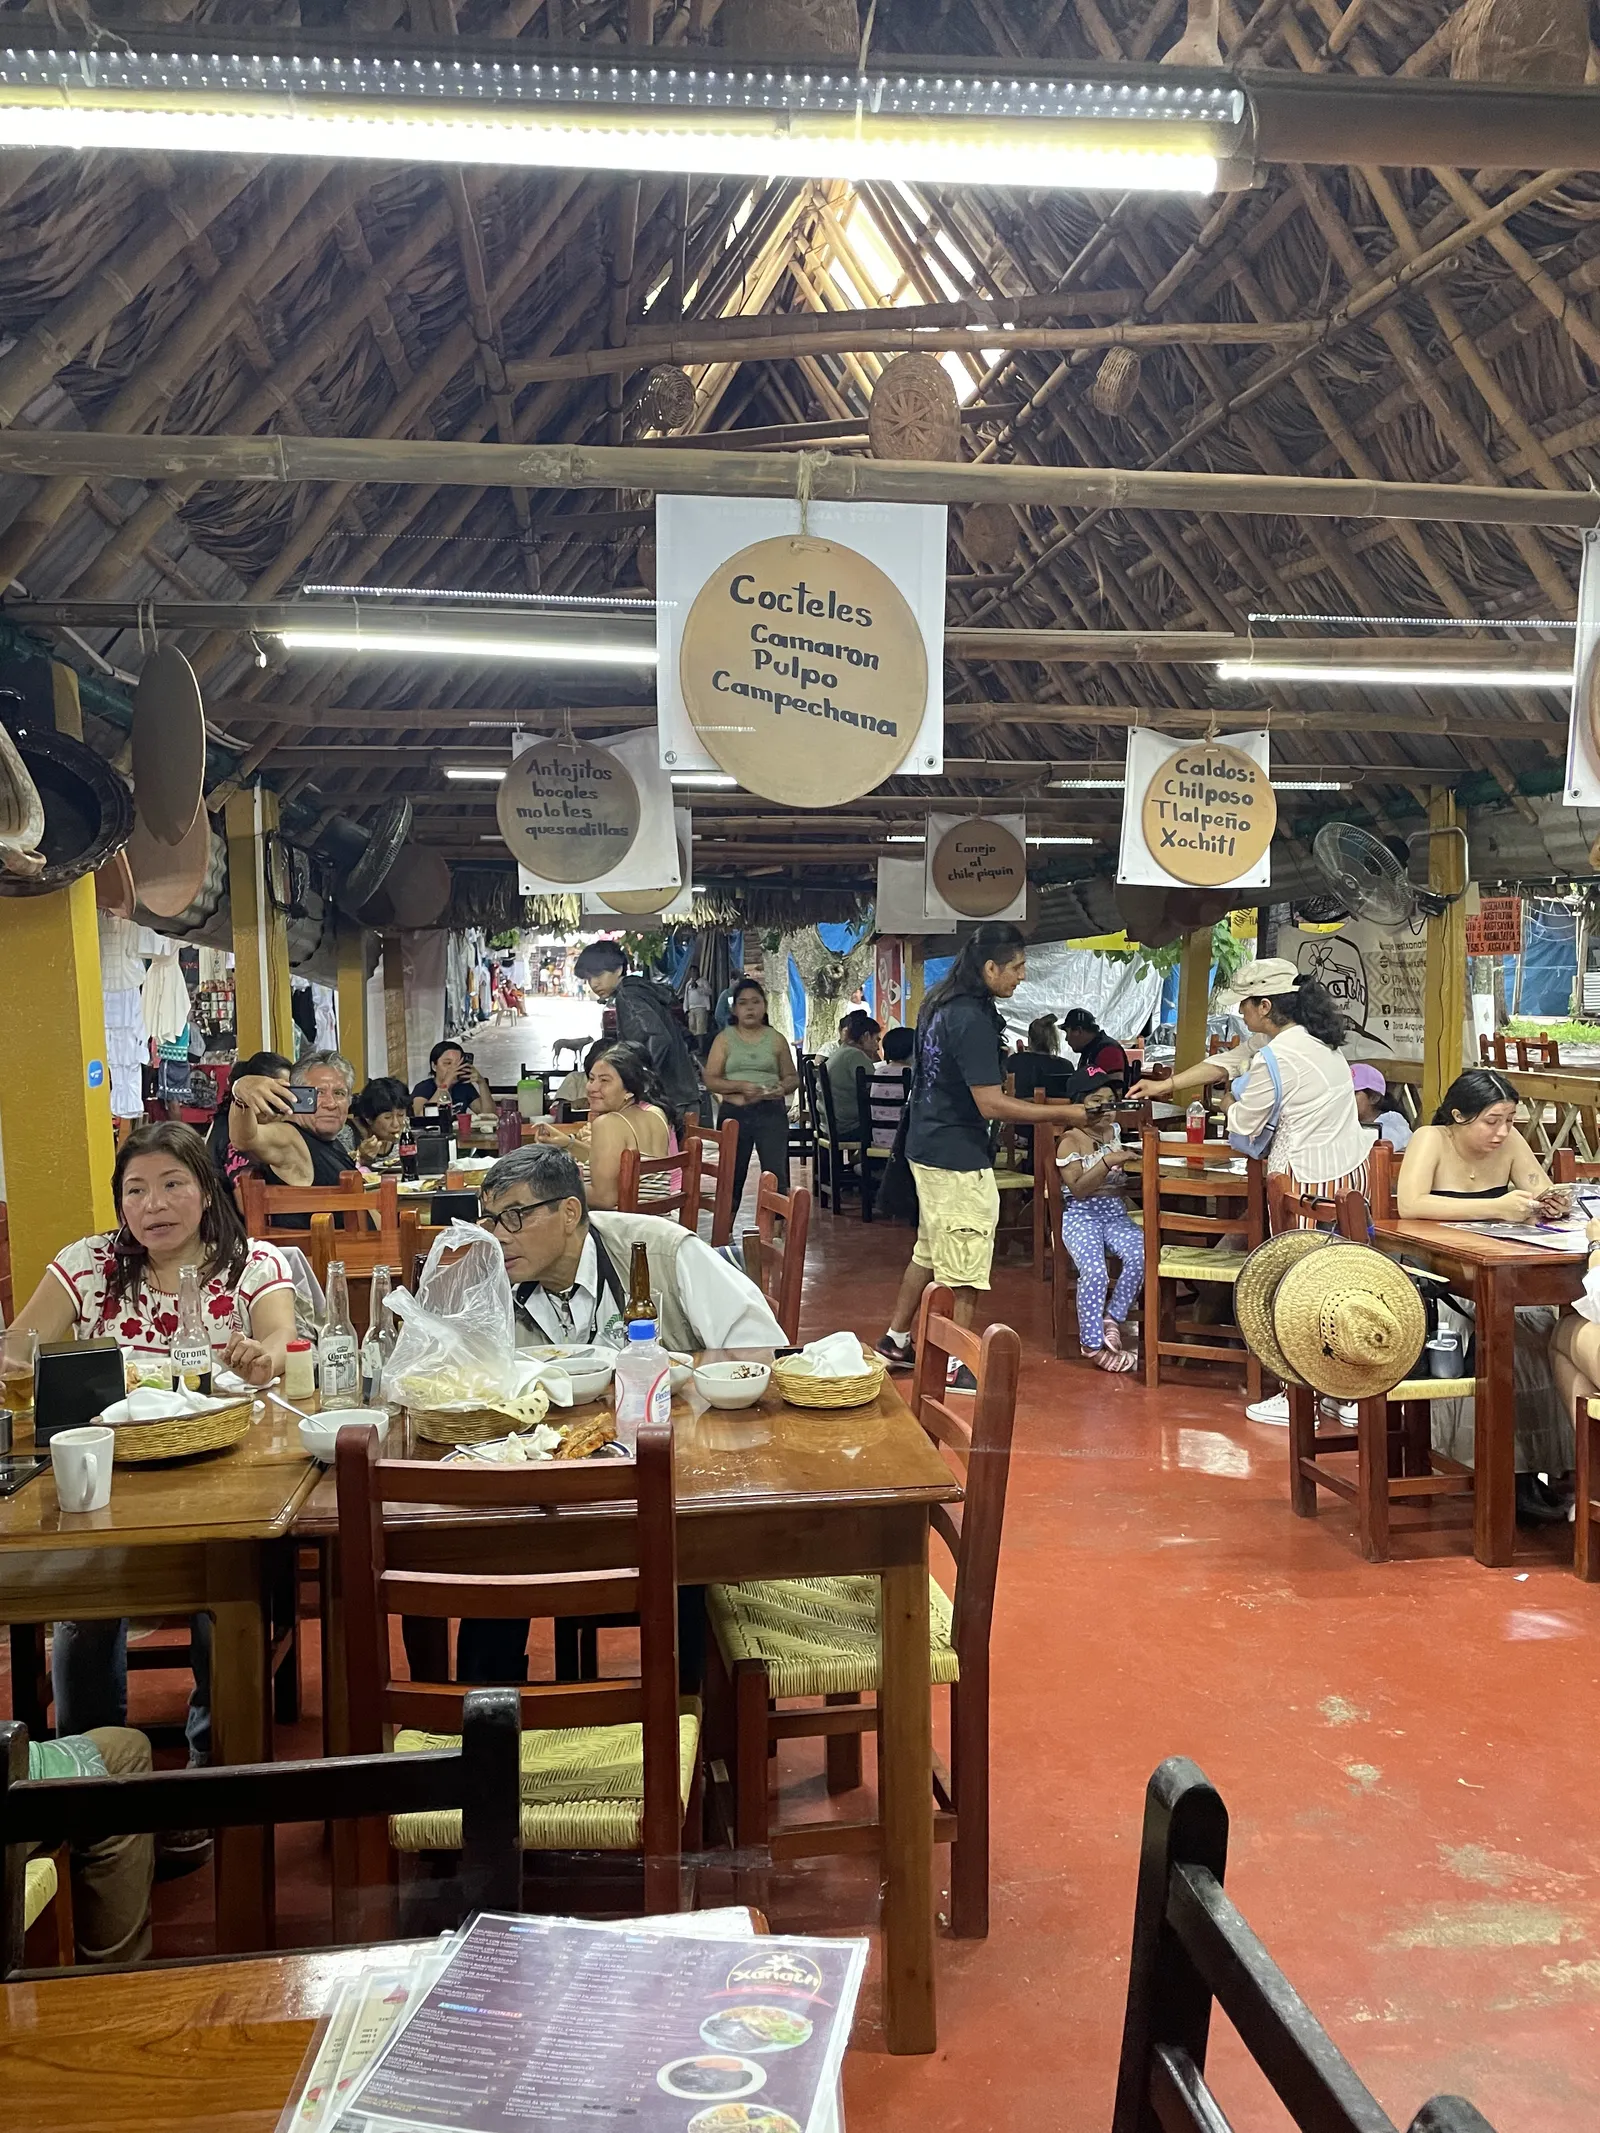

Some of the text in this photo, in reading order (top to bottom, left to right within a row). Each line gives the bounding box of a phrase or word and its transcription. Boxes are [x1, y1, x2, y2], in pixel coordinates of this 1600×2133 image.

[730, 574, 873, 627] Cocteles
[751, 623, 879, 670] Camaron
[751, 649, 838, 690] Pulpo
[712, 670, 897, 737] Campechana
[526, 759, 612, 782] Antojitos
[1175, 758, 1255, 783] Caldos:
[532, 781, 599, 799] bocoles
[1164, 779, 1254, 806] Chilposo
[516, 801, 592, 819] molotes
[1151, 799, 1251, 832] Tlalpeño
[525, 823, 628, 840] quesadillas
[1160, 827, 1235, 856] Xochitl
[955, 843, 996, 856] Conejo
[969, 857, 982, 867] al
[948, 867, 1014, 882] chile piquin
[174, 1349, 208, 1361] Corona
[327, 1352, 356, 1361] Corona
